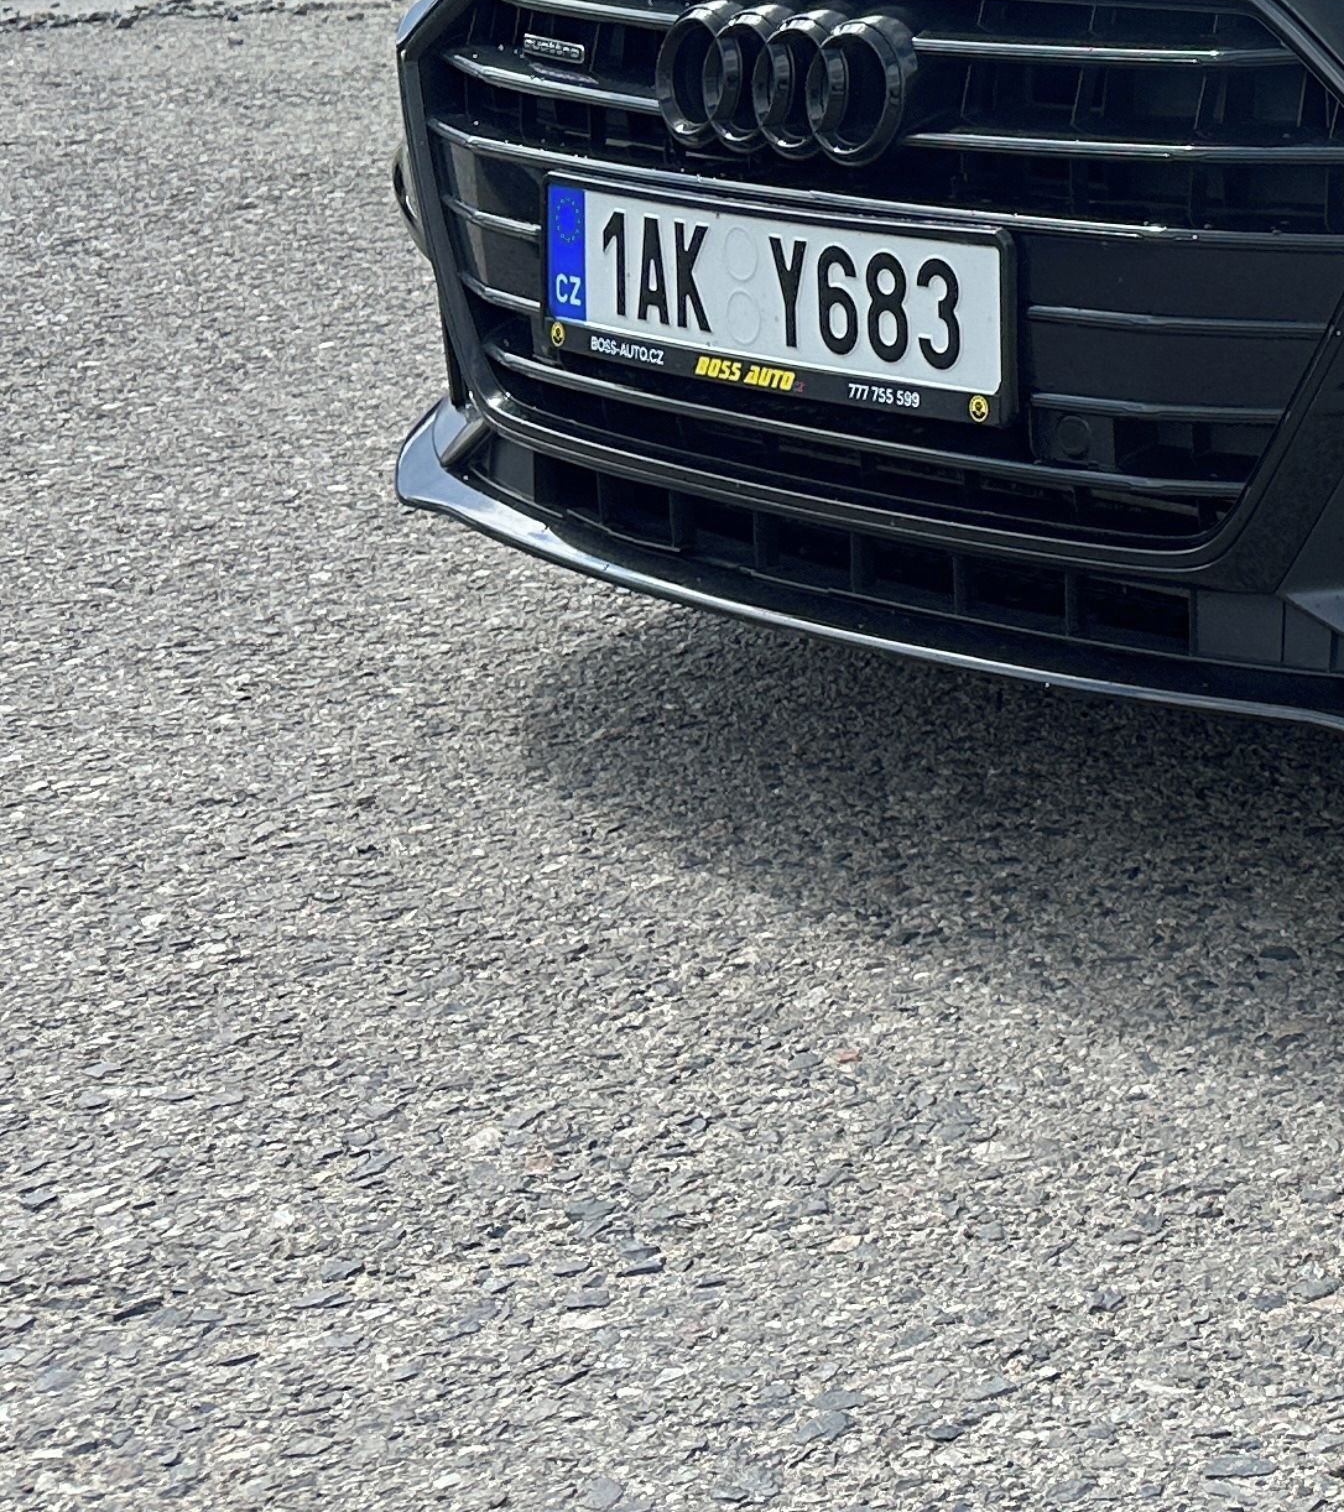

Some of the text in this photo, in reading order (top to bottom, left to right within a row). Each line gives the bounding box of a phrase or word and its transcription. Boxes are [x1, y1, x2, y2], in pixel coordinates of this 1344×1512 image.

[556, 273, 582, 306] CZ
[602, 210, 961, 371] 1AK Y683
[591, 336, 665, 365] BOSS-AUTO.CZ
[695, 356, 742, 382] BOSS
[744, 365, 796, 391] AUTO
[848, 383, 920, 408] 777 755 599
